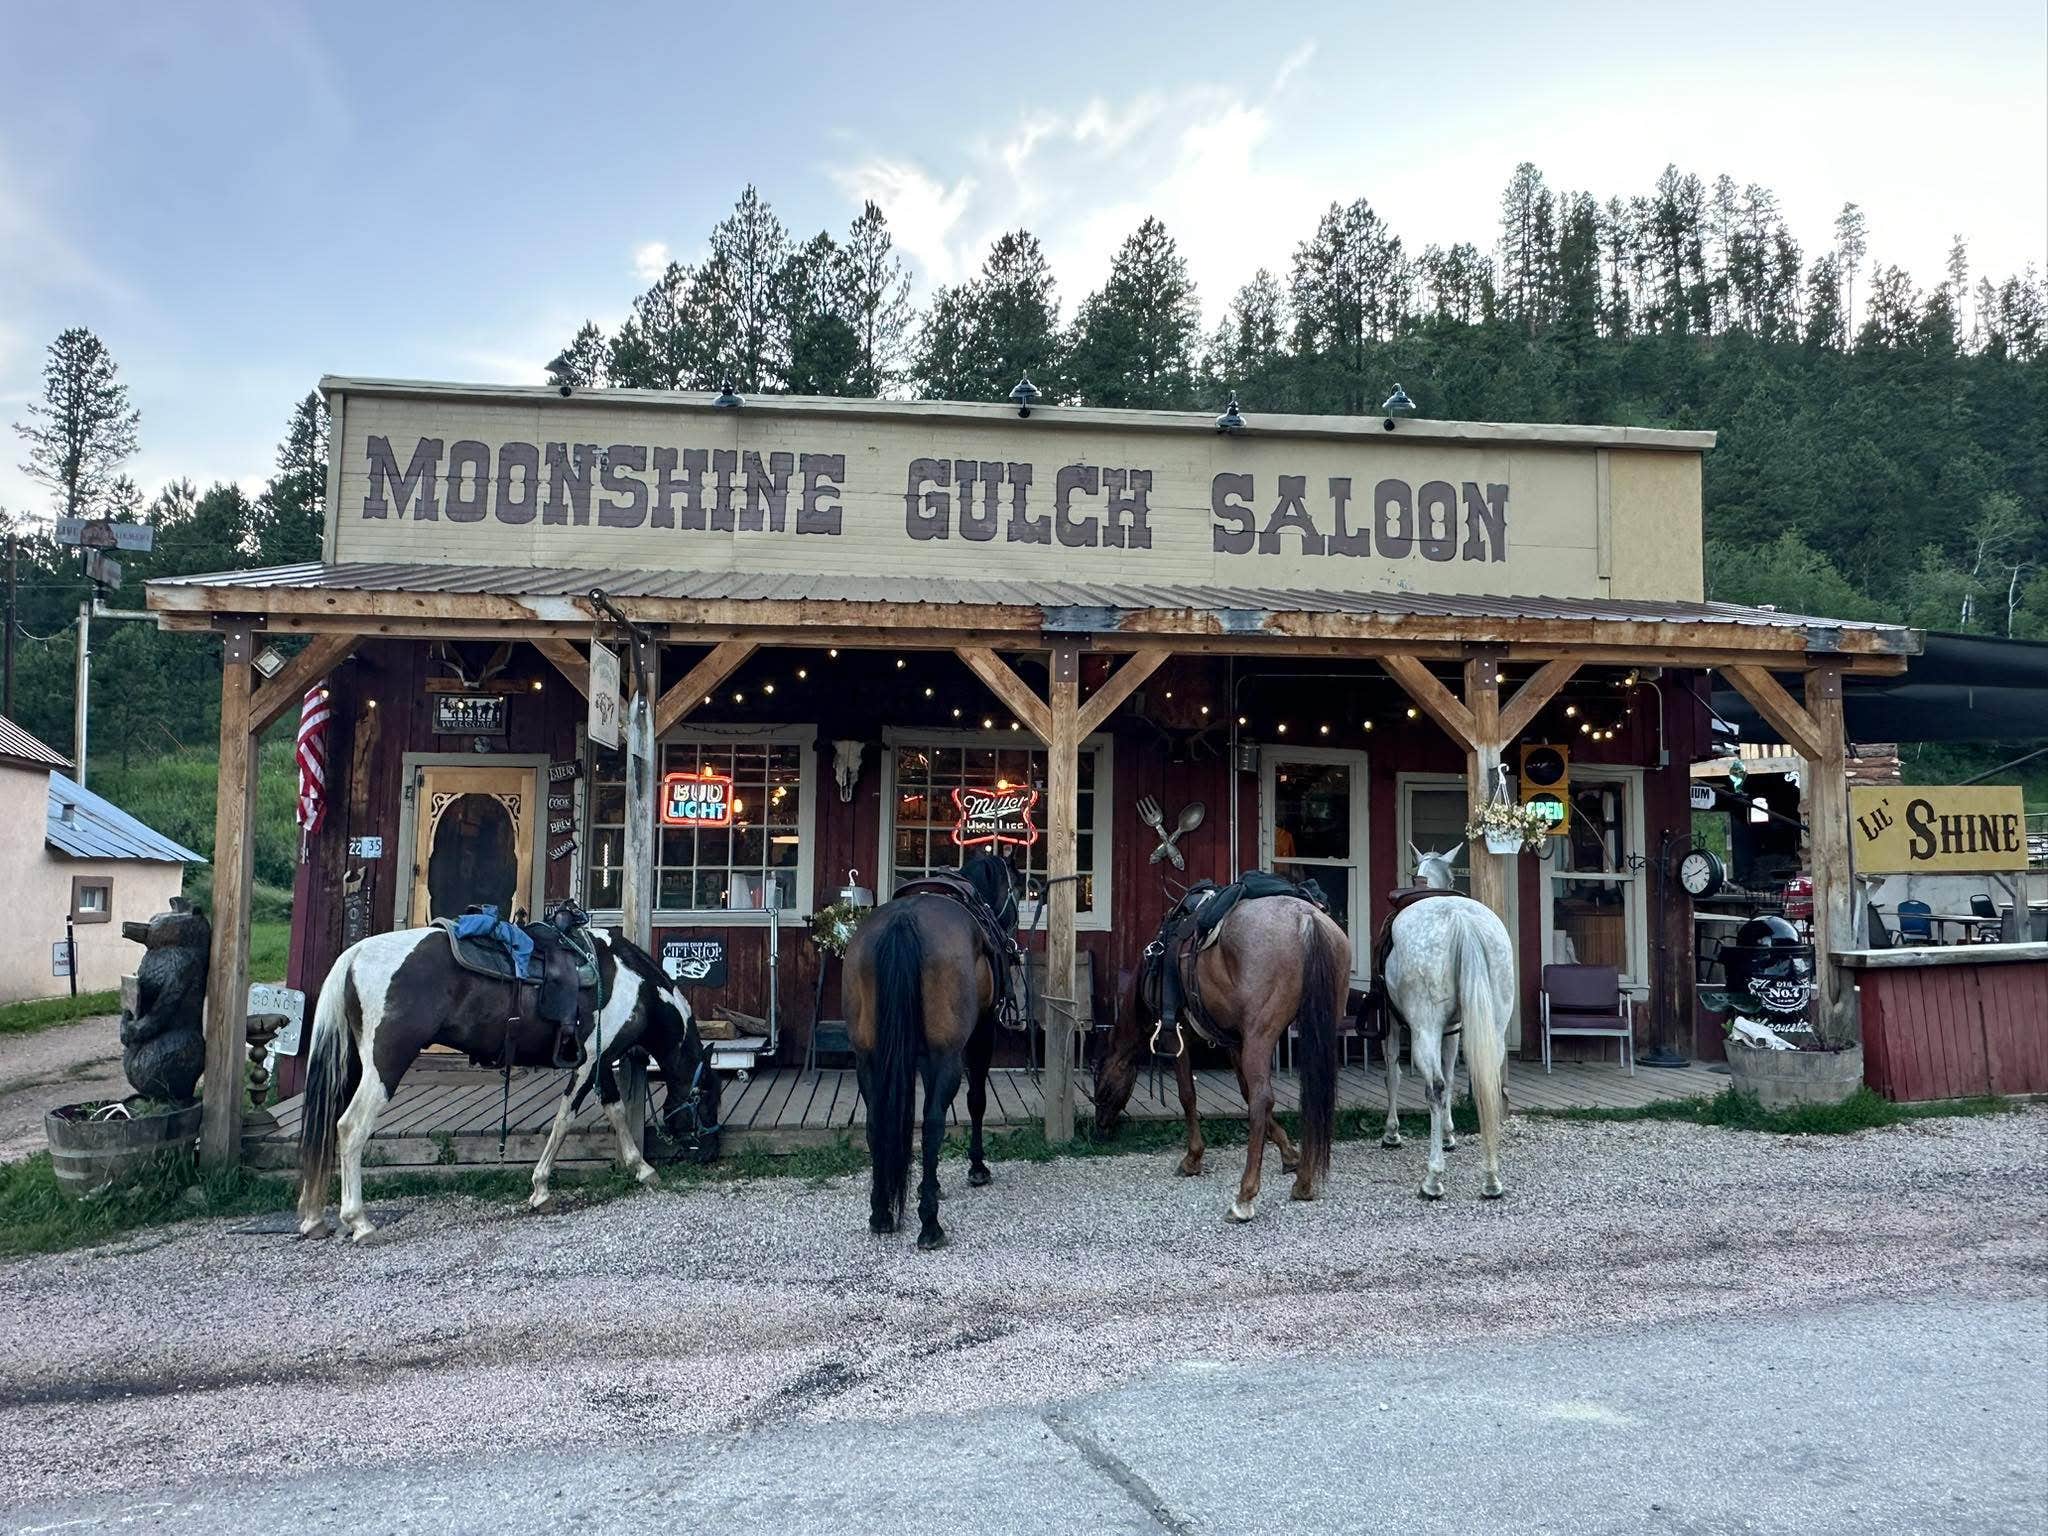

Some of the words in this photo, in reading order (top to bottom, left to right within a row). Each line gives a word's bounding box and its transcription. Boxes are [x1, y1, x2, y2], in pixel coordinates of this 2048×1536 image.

[362, 435, 845, 536] MOONSHINE
[905, 458, 1153, 550] GULCH
[1211, 472, 1510, 563] SALOON
[673, 784, 723, 803] BUD
[668, 800, 727, 819] LIGHT
[1525, 801, 1564, 820] OPEN
[1906, 799, 2020, 860] SHINE
[663, 945, 690, 957] GIFT
[691, 945, 722, 958] SHOP
